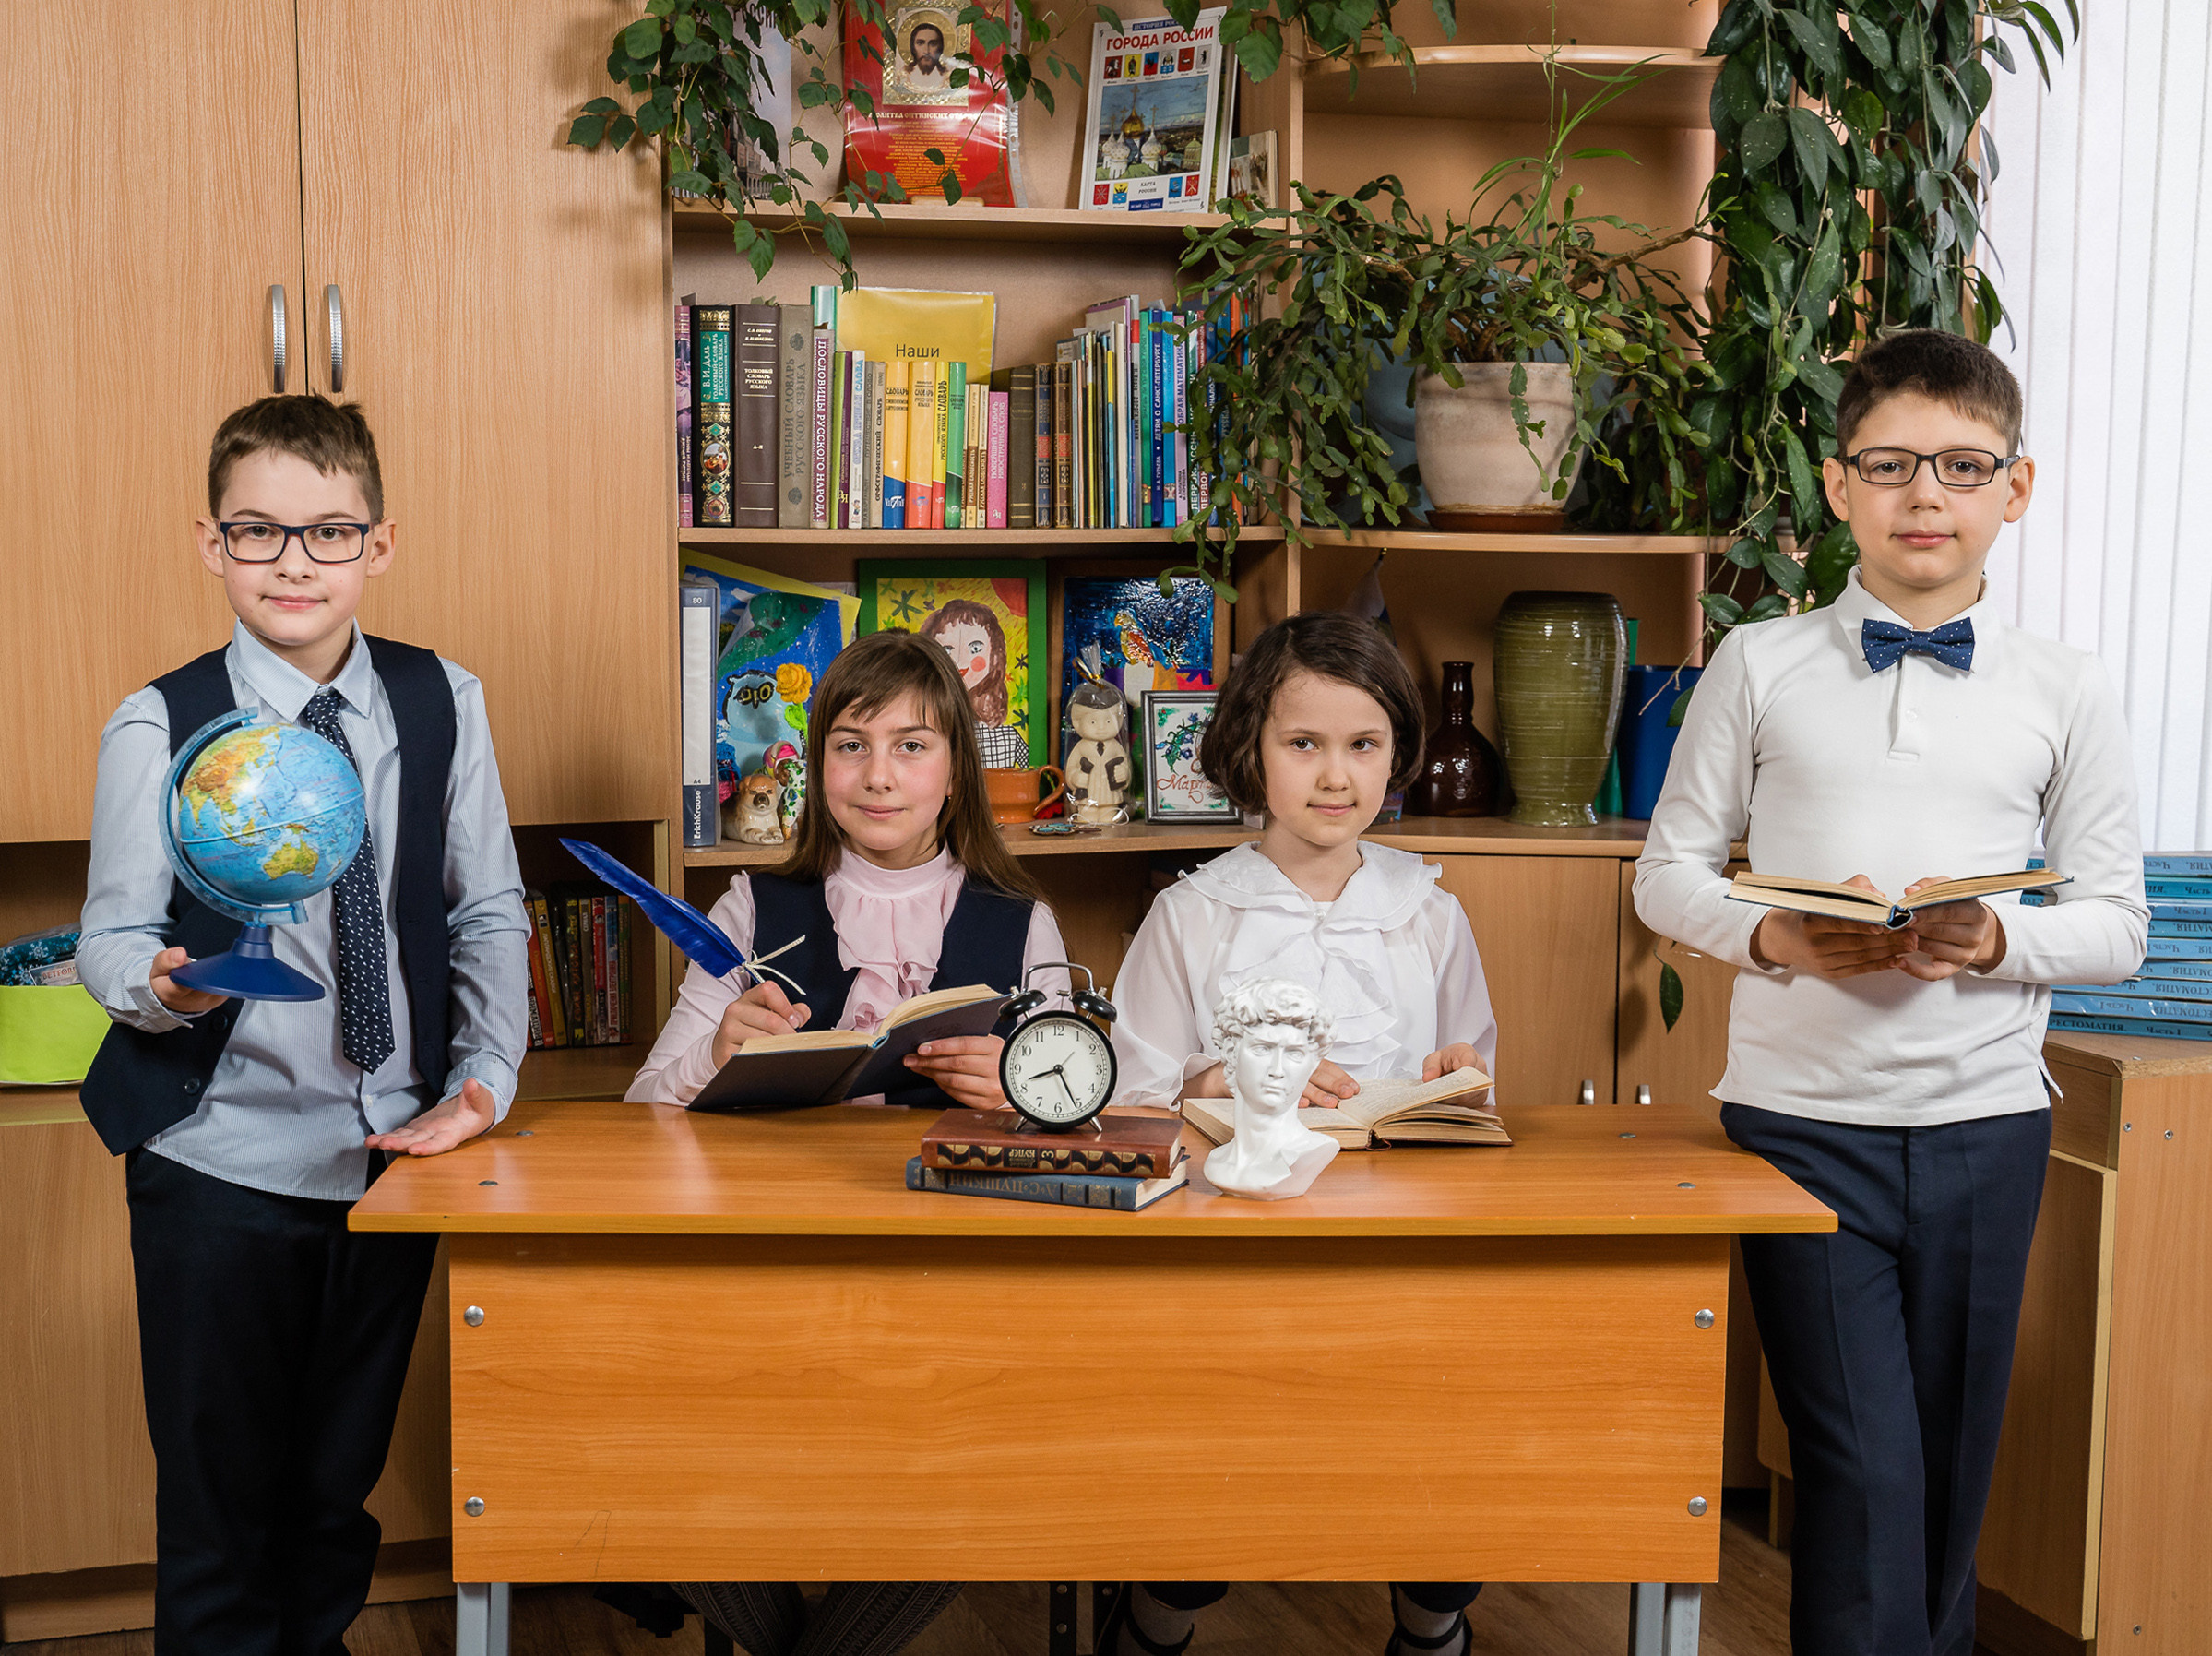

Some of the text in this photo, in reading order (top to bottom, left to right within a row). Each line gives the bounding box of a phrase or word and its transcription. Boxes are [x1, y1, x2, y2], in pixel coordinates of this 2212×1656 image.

[1107, 26, 1214, 50] ГОРОДА РОССИИ
[896, 344, 940, 358] Наши
[854, 359, 863, 392] СЛОВА
[1154, 342, 1162, 409] САНКТ-ПЕТЕРБУРГЕ
[886, 387, 909, 396] СЛОВАРЬ
[937, 380, 947, 412] СЛОВАРЬ
[784, 358, 795, 479] УЧЕБНЫЙ СЛОВАРЬ
[795, 363, 806, 474] РУССКОГО ЯЗЫКА
[815, 340, 827, 518] ПОСЛОВИЦЫ РУССКОГО НАРОДА
[990, 401, 999, 480] НОВЕЙШИЙ СЛОВАРЬ
[997, 423, 1005, 480] ИНОСТРАННЫХ
[691, 596, 703, 605] 80
[693, 790, 703, 840] ErichKrause
[2173, 923, 2212, 933] МАТИЯ.
[2170, 965, 2212, 977] ОМАТИЯ.
[2152, 983, 2212, 996] ЕСТОМАТИЯ.
[1052, 1025, 1064, 1037] 12
[2049, 1019, 2127, 1032] РЕСТОМАТИЯ.
[2147, 1025, 2176, 1036] Часть
[1035, 1031, 1044, 1042] 11
[1075, 1031, 1080, 1042] 1
[1021, 1044, 1032, 1056] 10
[1088, 1044, 1097, 1056] 2
[1014, 1063, 1022, 1075] 9
[1095, 1064, 1103, 1076] 3
[1020, 1083, 1029, 1094] 8
[1088, 1083, 1096, 1094] 4
[1036, 1096, 1043, 1108] 7
[1054, 1102, 1063, 1114] 6
[1075, 1097, 1083, 1109] 5
[1008, 1149, 1036, 1158] КУПЕР
